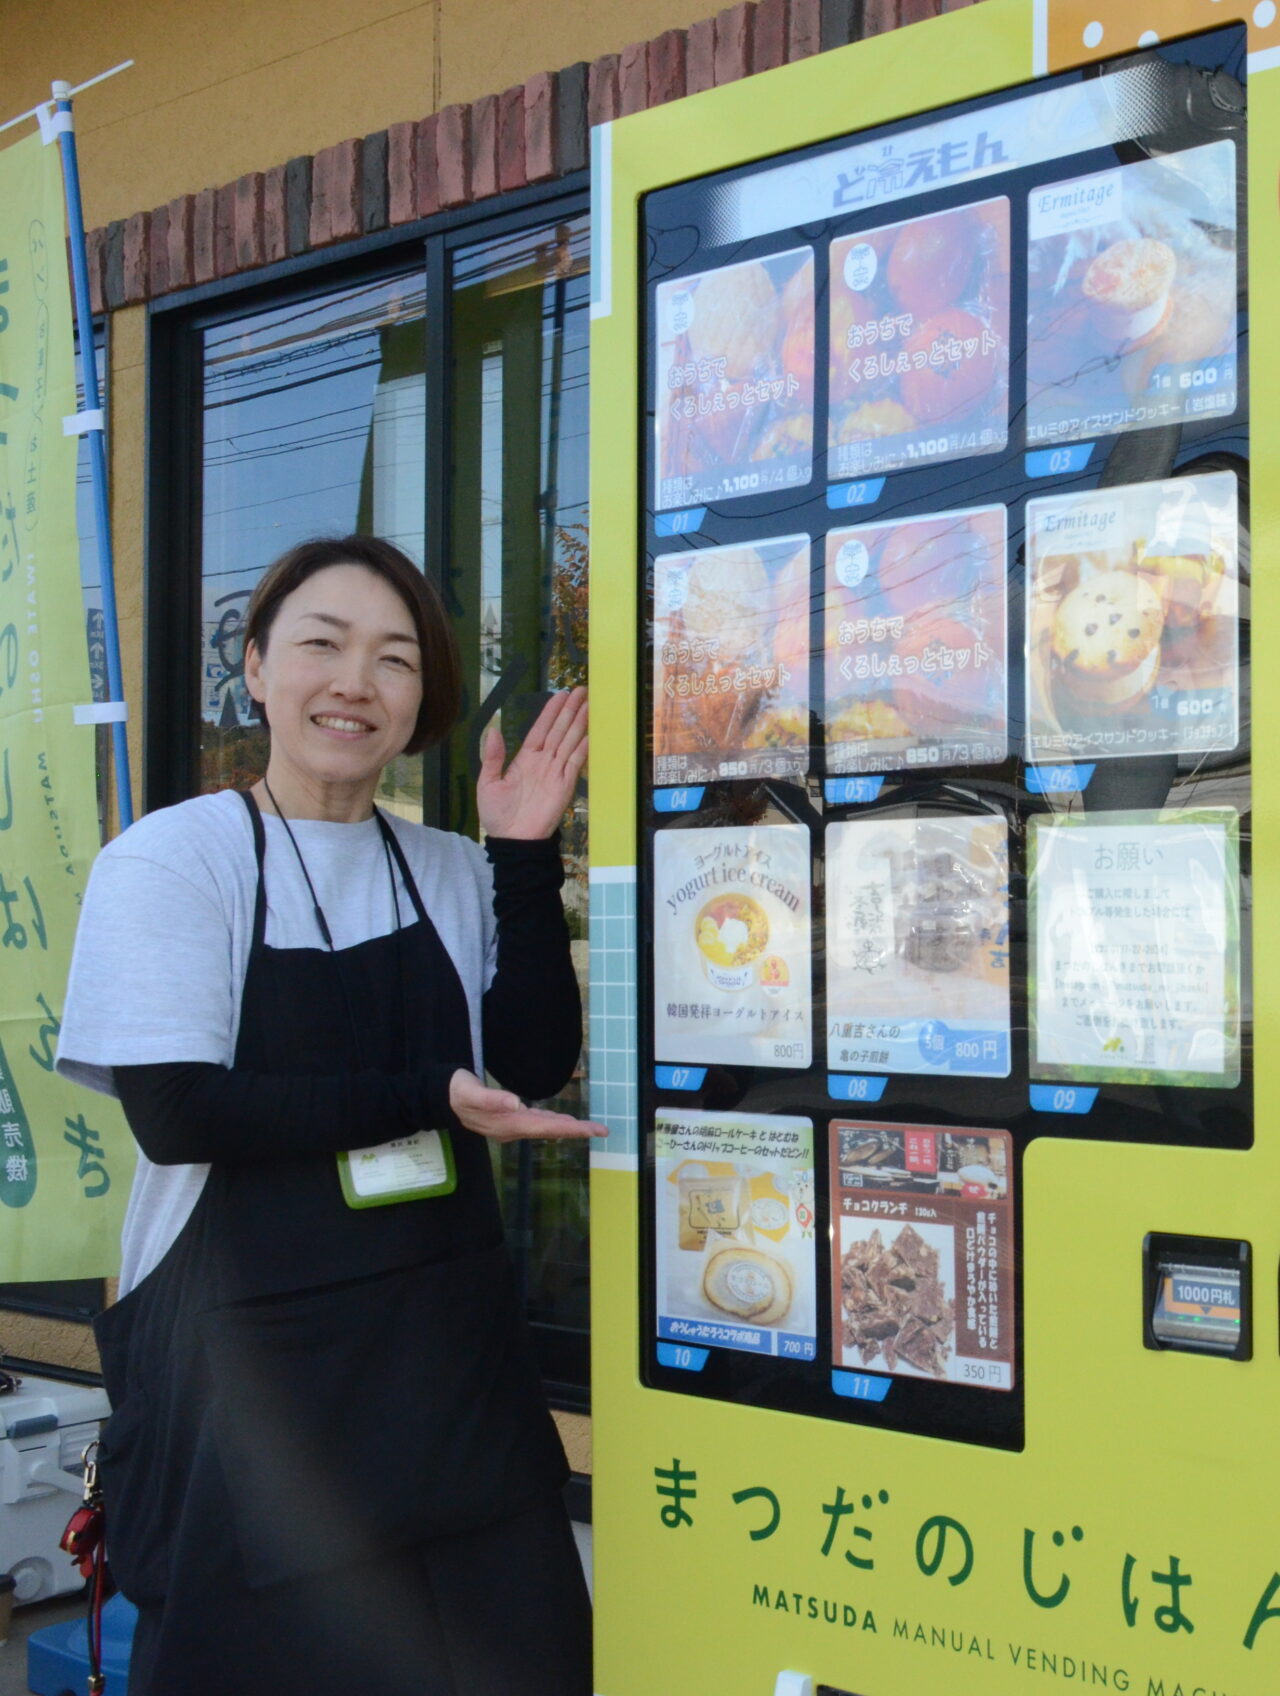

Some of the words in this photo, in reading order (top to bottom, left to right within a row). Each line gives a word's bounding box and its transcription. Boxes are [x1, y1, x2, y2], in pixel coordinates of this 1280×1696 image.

[1038, 180, 1114, 215] Ermitage
[847, 313, 913, 348] おうちで
[668, 357, 727, 388] おうちで
[1179, 367, 1217, 388] 600
[1051, 450, 1071, 472] 03
[846, 484, 867, 505] 02
[671, 513, 689, 533] 01
[1043, 509, 1116, 534] Ermitage
[839, 615, 904, 645] おうちで
[662, 637, 719, 665] おうちで
[1177, 698, 1213, 716] 600
[844, 781, 863, 799] 05
[1050, 769, 1072, 790] 06
[670, 790, 688, 809] 04
[693, 842, 772, 869] ヨーグルトアイス
[1094, 842, 1164, 871] お願い
[666, 867, 718, 915] yogurt
[721, 862, 747, 882] ice
[749, 870, 801, 912] cream
[667, 1002, 804, 1021] 韓国発祥ヨーグルトアイス
[773, 1043, 804, 1060] 800円
[671, 1069, 689, 1087] 07
[848, 1078, 867, 1098] 08
[1053, 1089, 1076, 1110] 09
[843, 1197, 908, 1216] チョコクランチ
[1178, 1285, 1235, 1305] 1000円札
[674, 1348, 691, 1367] 10
[964, 1363, 985, 1380] 350
[852, 1377, 870, 1396] 11
[753, 1584, 877, 1634] MATSUDA
[893, 1617, 995, 1661] MANUAL
[1008, 1643, 1130, 1691] VENDING
